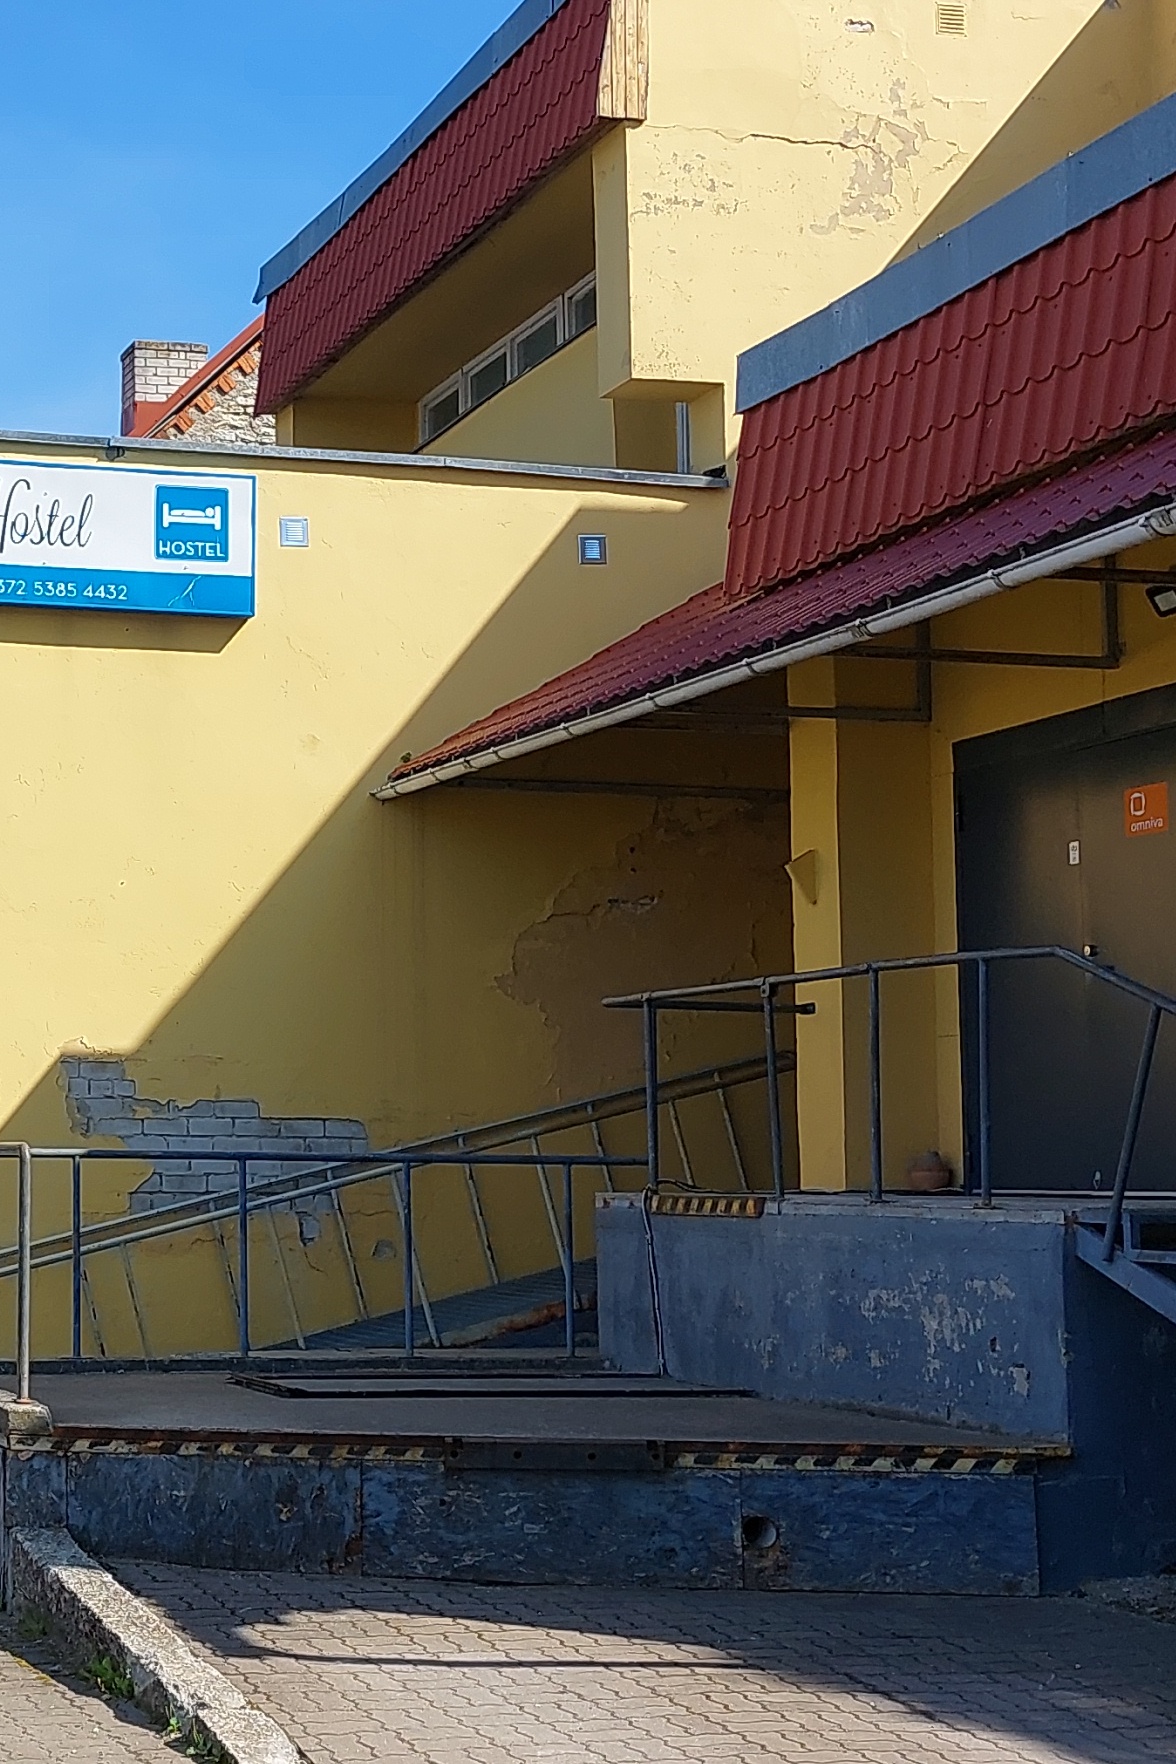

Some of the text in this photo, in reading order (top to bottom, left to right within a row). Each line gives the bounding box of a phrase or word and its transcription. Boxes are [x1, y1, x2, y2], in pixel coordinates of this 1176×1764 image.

[159, 540, 225, 557] HOSTEL
[33, 581, 77, 597] 5385
[82, 583, 128, 600] 4432
[1130, 817, 1163, 832] omniva
